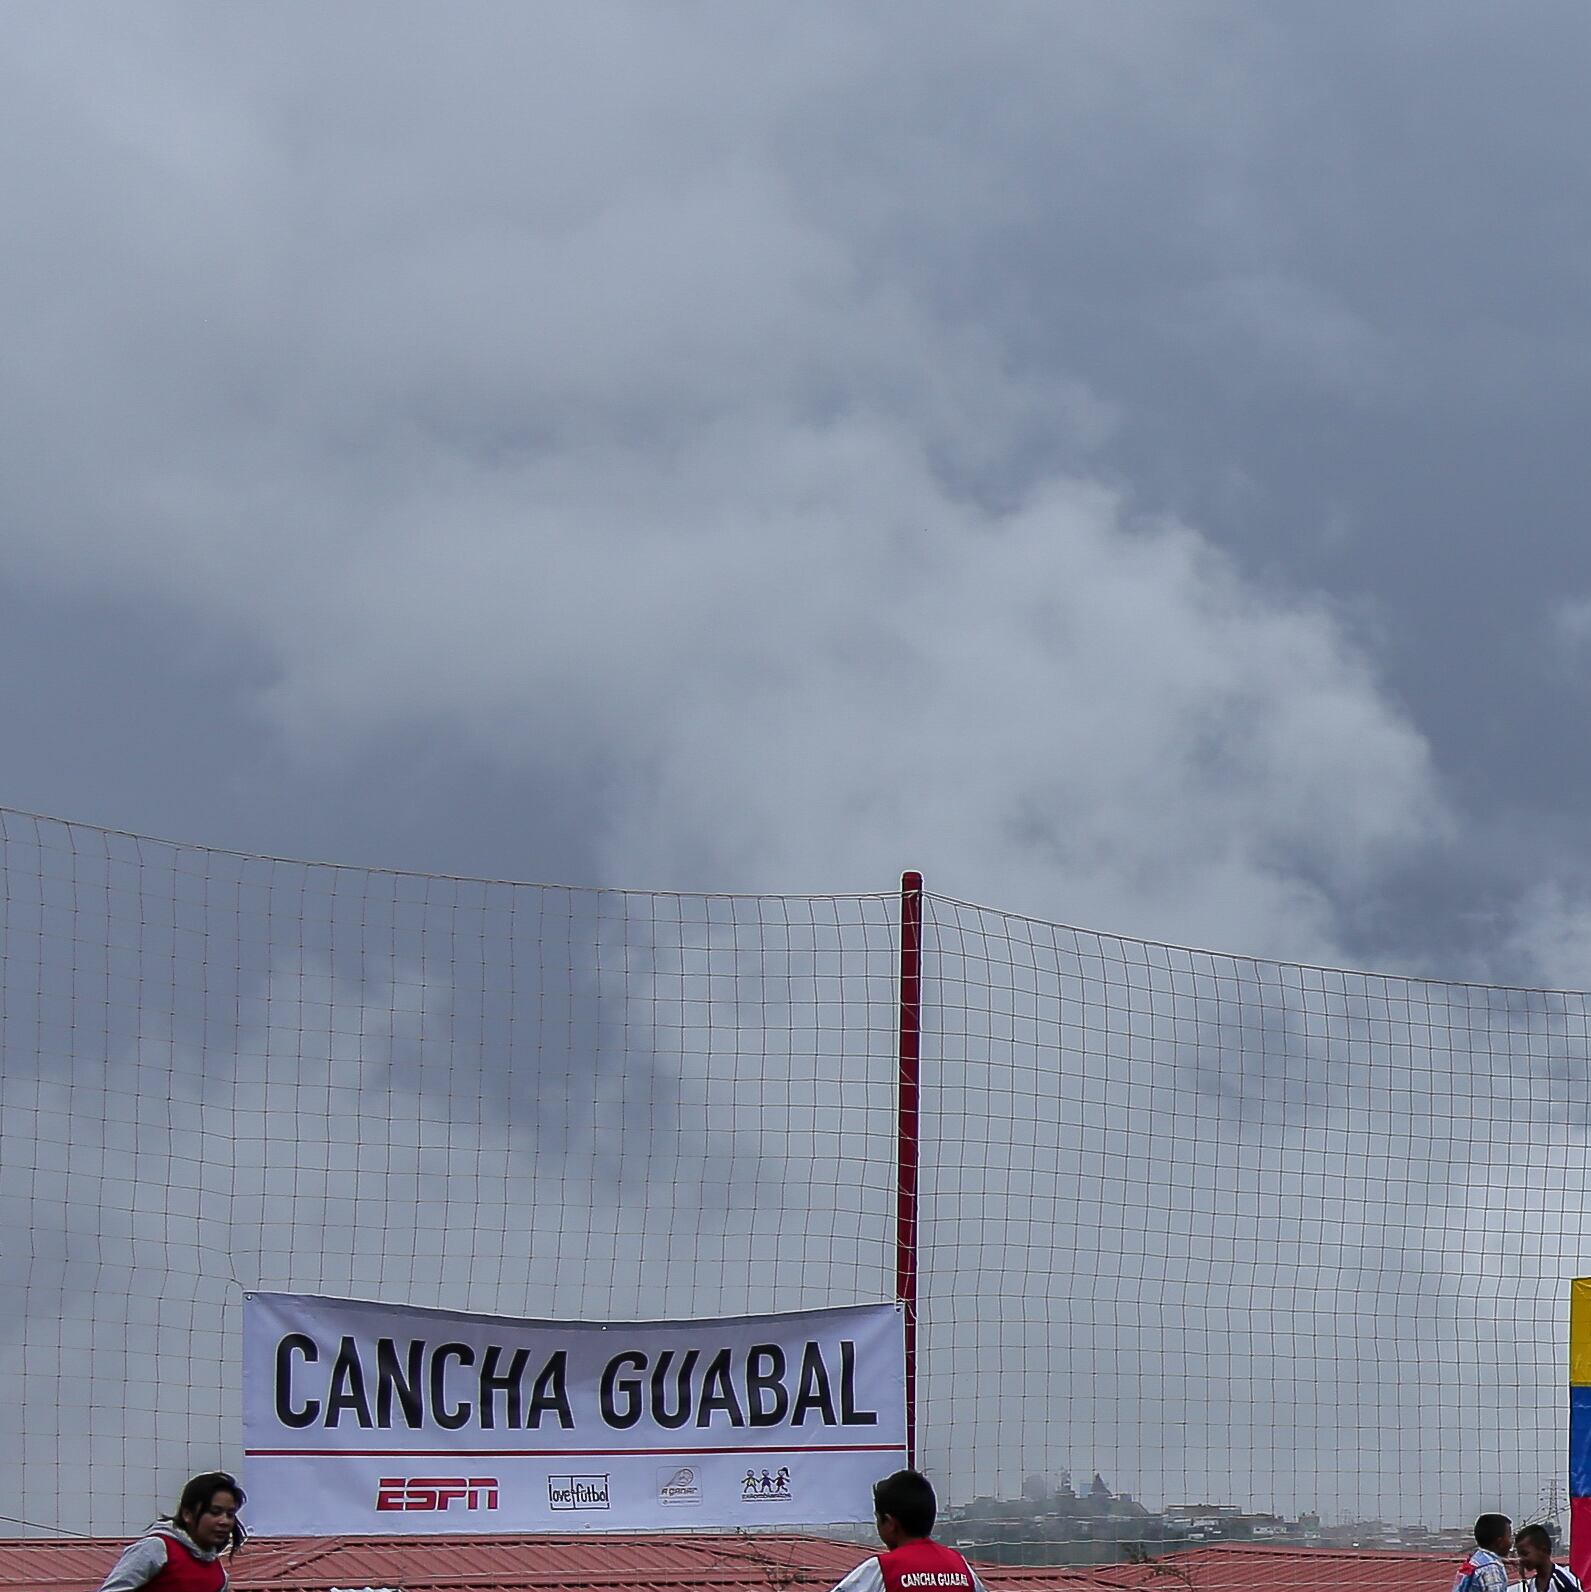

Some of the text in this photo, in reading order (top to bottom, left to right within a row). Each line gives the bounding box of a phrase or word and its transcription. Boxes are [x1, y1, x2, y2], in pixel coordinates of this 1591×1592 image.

[275, 1333, 878, 1429] CANCHA GUABAL
[376, 1478, 498, 1511] ESPN
[901, 1573, 937, 1588] CANCHA
